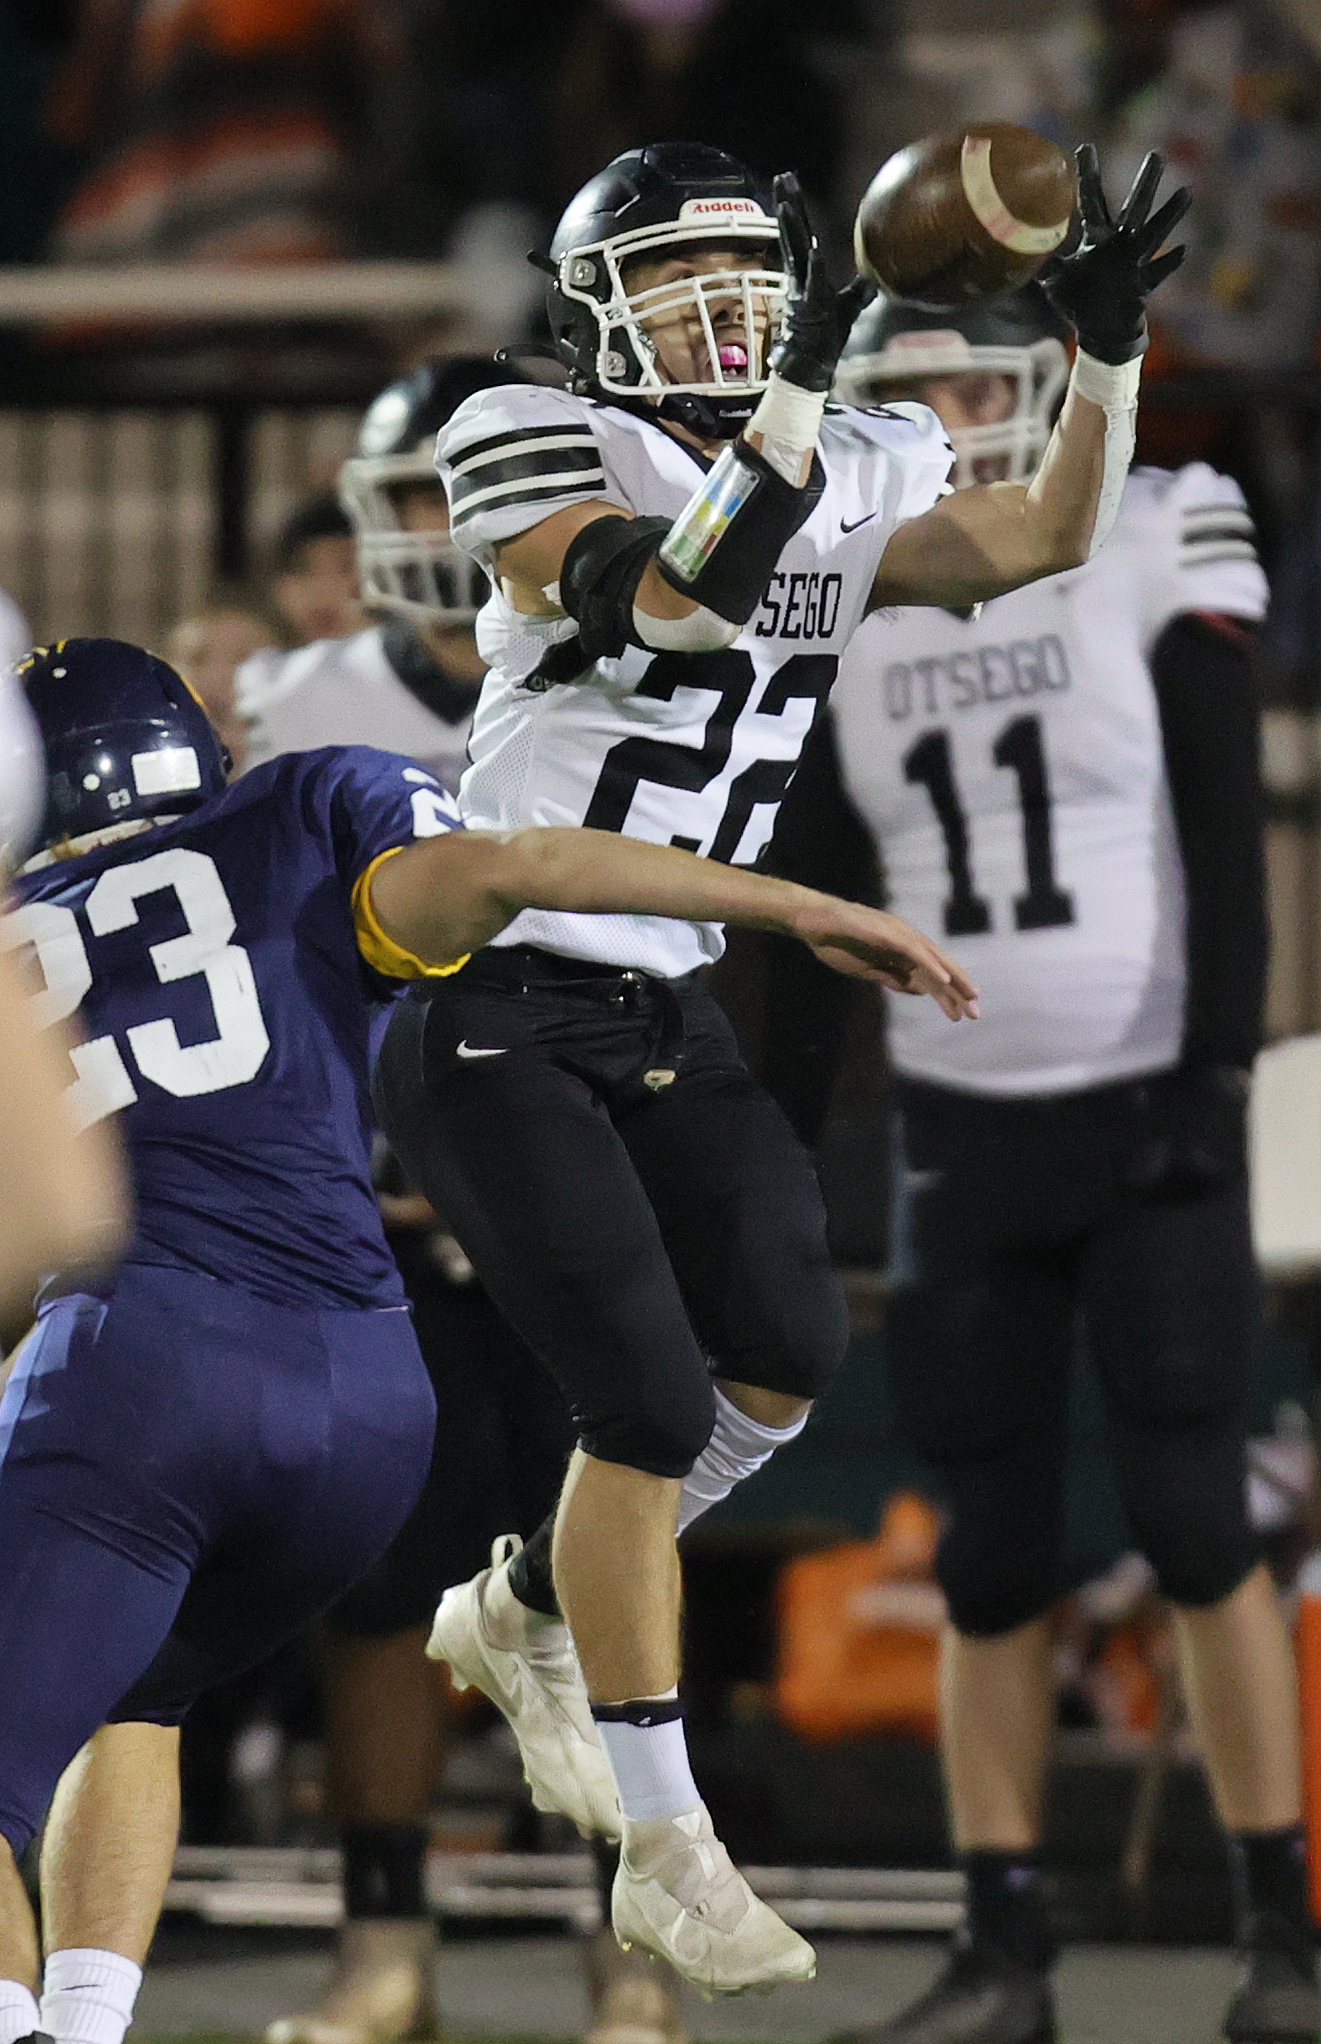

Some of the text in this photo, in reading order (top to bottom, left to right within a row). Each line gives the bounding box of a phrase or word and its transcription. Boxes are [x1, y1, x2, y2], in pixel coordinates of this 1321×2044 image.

[756, 572, 842, 639] SEGO
[884, 633, 1072, 720] OTSEGO
[583, 648, 839, 865] 22
[905, 711, 1075, 936] 11
